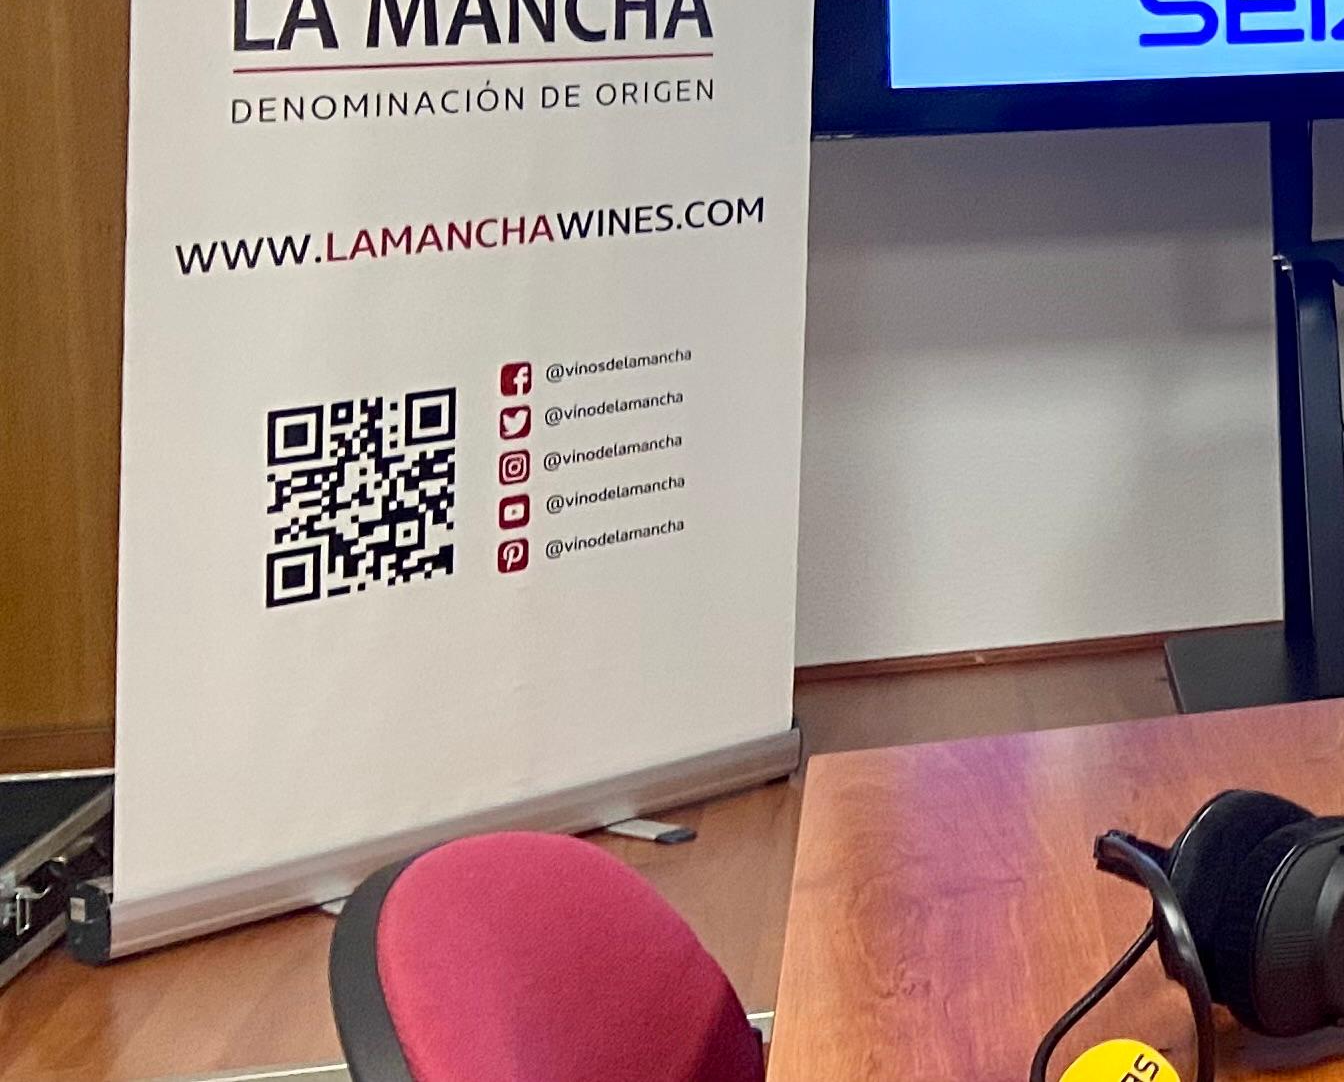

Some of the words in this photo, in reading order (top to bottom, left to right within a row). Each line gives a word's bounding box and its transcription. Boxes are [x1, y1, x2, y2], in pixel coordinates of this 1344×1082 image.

[231, 79, 526, 125] DENOMINACIÓN
[541, 83, 581, 110] DE
[595, 78, 716, 108] ORIGEN
[174, 196, 766, 276] WWW.LAMANCHAWINES.COM
[545, 345, 692, 385] @vinosdelamancha
[544, 389, 684, 428] @vinodelamancha
[542, 432, 683, 472] @vinodelamancha
[545, 473, 686, 515] @vinodelamancha
[545, 517, 686, 559] @vinodelamancha
